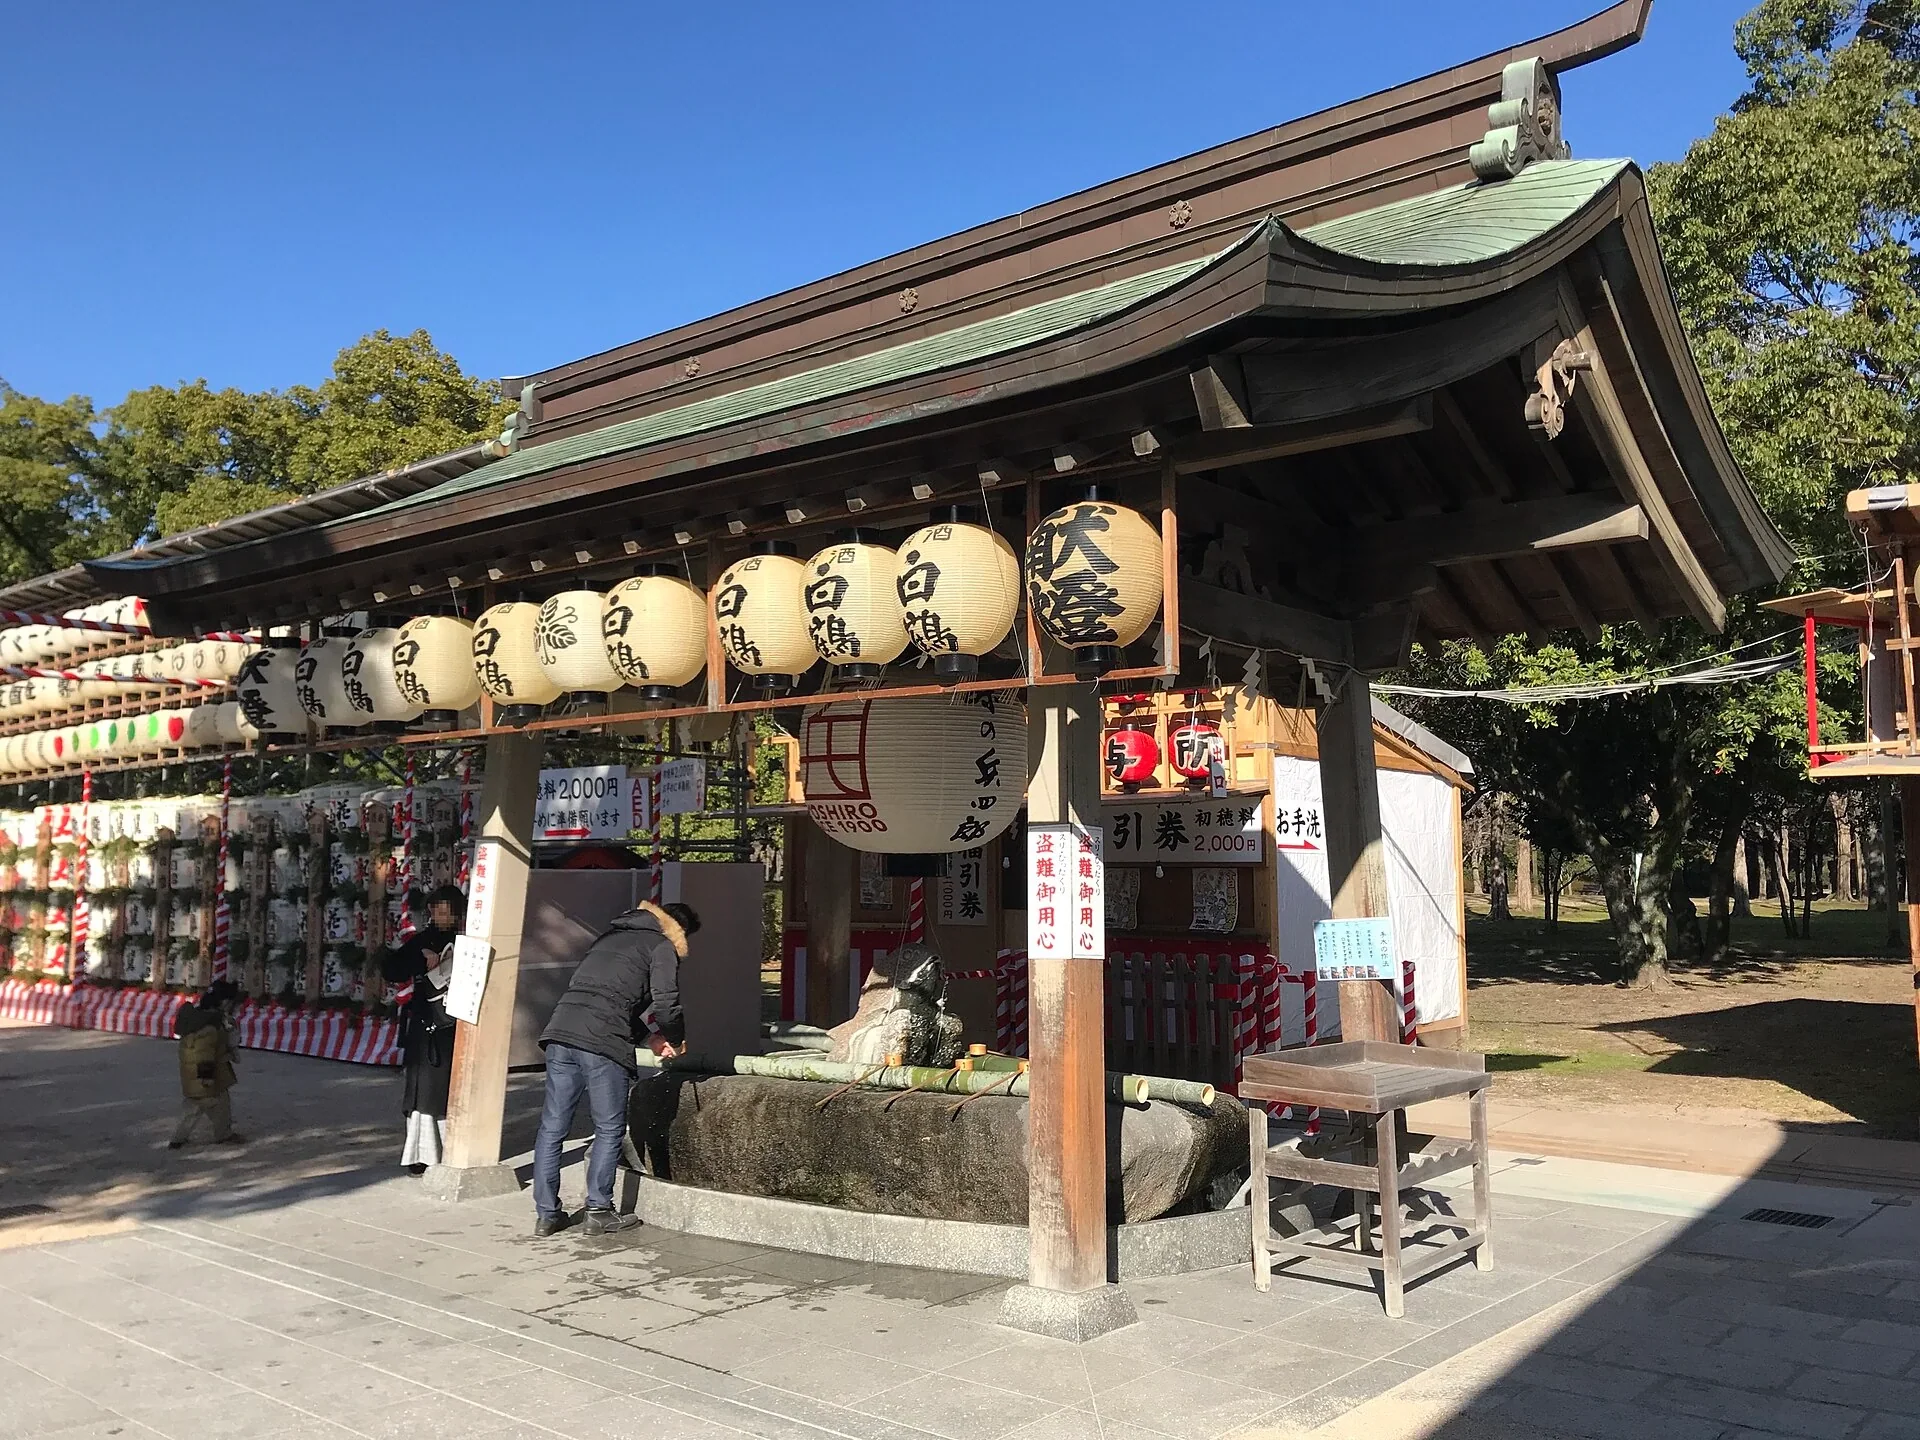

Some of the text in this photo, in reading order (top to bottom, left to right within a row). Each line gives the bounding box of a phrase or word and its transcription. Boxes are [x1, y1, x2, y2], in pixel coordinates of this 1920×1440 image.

[716, 573, 763, 667] 白鶴
[804, 563, 860, 658] 白鶴
[897, 550, 959, 652] 白鶴
[392, 630, 430, 705] 白鶴
[472, 618, 514, 697] 白鶴
[602, 594, 650, 680] 白鶴
[295, 649, 326, 718] 白鶴
[342, 642, 375, 713] 白鶴
[1104, 738, 1138, 777] 与
[1213, 745, 1224, 789] 出口
[533, 809, 620, 828] めに準備願います
[632, 779, 642, 828] AED
[808, 802, 878, 820] OSHIRO
[838, 819, 888, 833] 1900
[1194, 807, 1256, 827] 初穂料
[1277, 807, 1322, 838] お手洗
[1194, 835, 1256, 854] 2,000円
[1036, 834, 1056, 949] 盗難御用心
[1078, 834, 1094, 950] 盗難御用心
